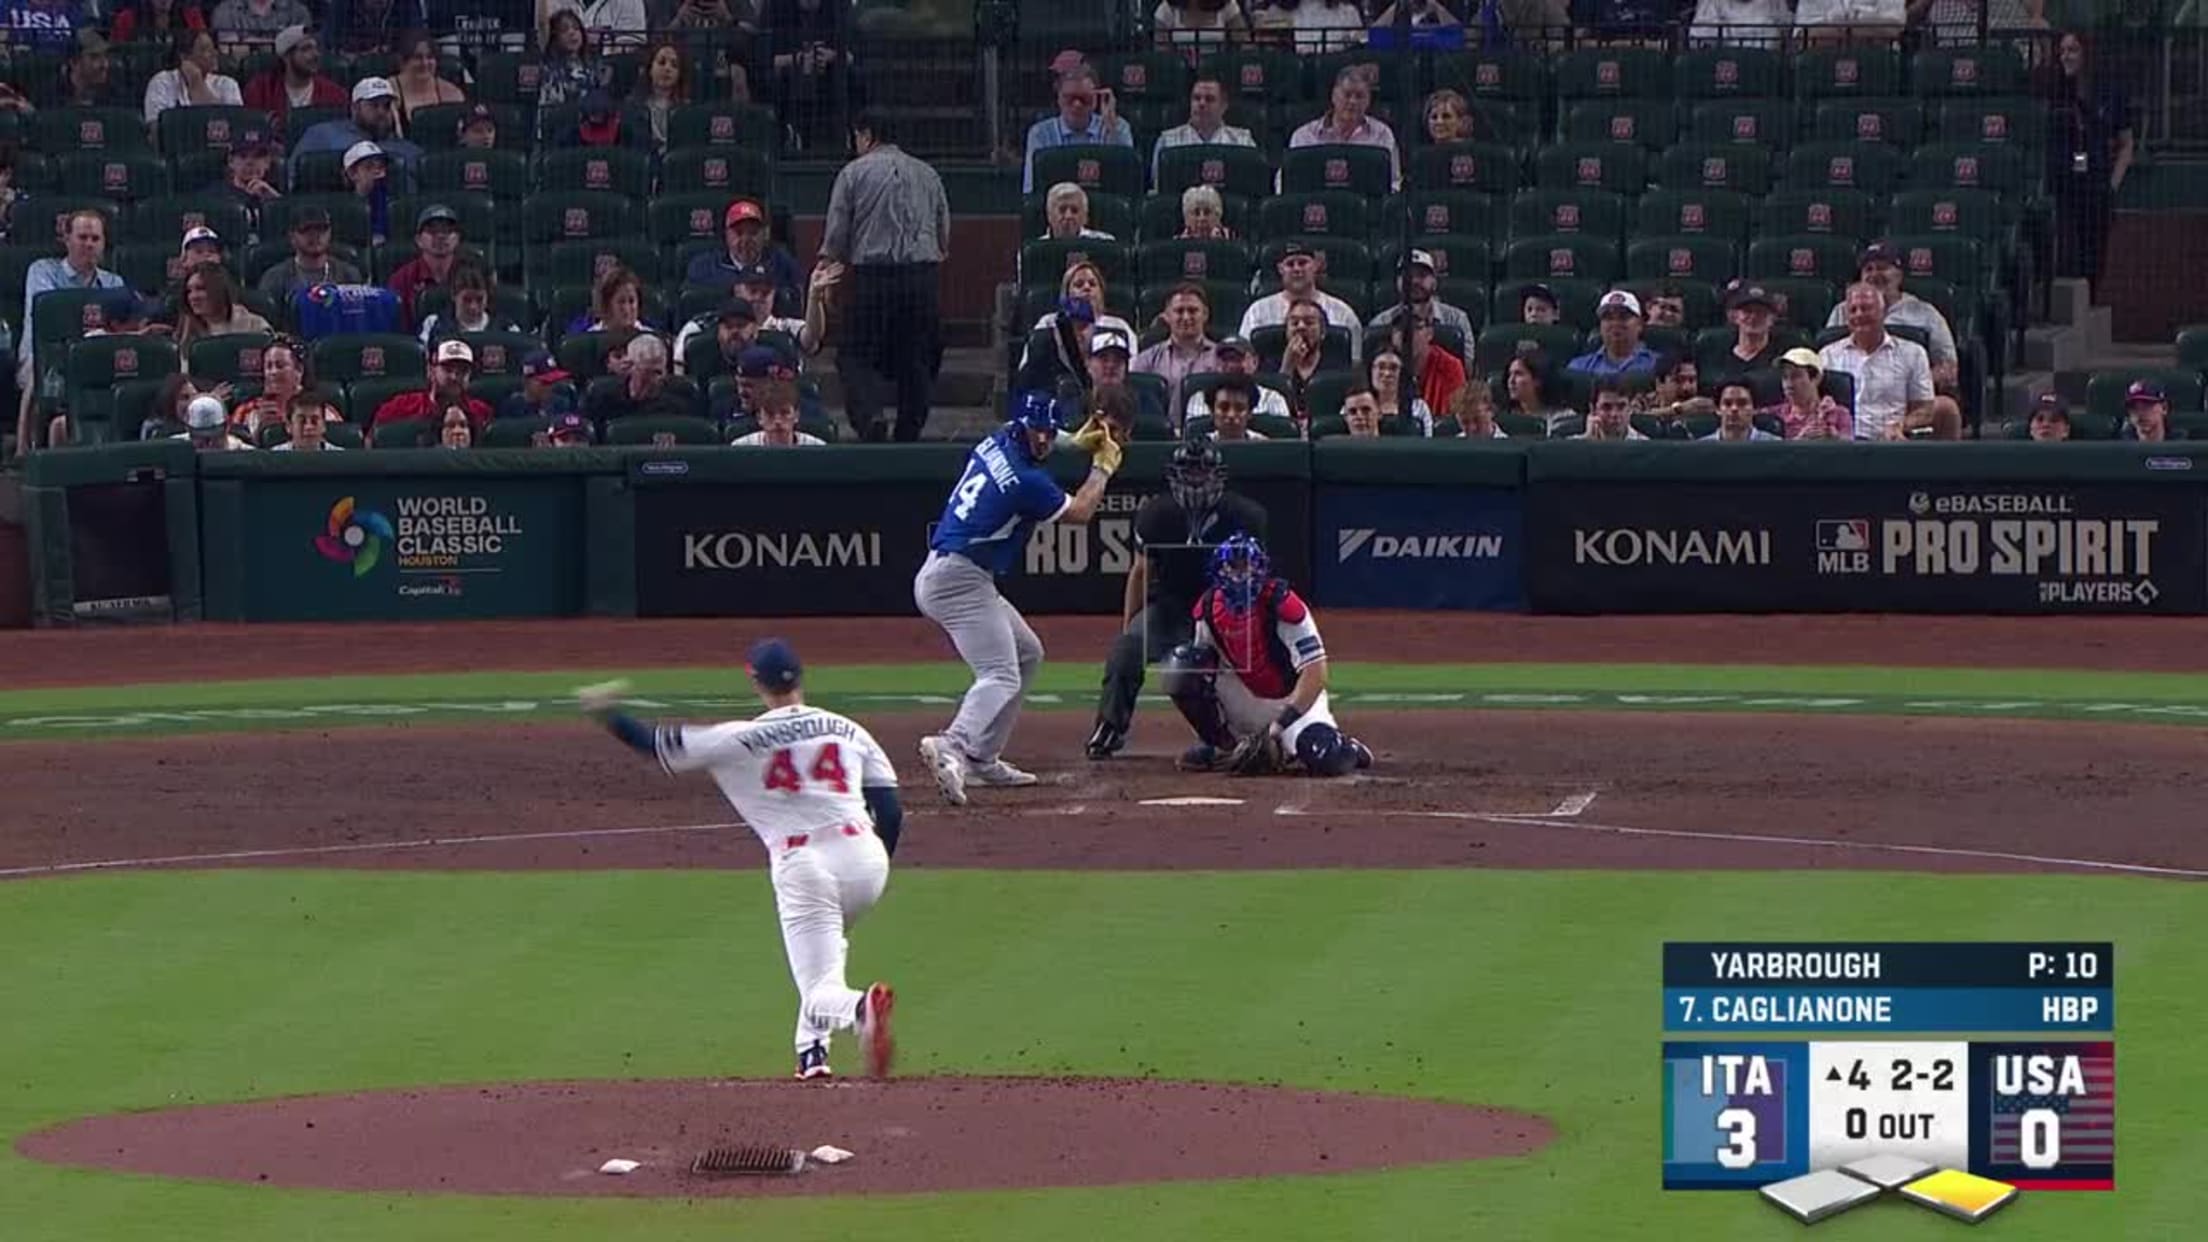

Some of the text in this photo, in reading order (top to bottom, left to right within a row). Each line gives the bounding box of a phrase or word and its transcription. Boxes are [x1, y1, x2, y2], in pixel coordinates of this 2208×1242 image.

[10, 8, 71, 37] USA
[397, 497, 487, 516] WORLD
[1935, 495, 2072, 513] eBASEBALL
[398, 515, 522, 536] BASEBALL
[398, 536, 502, 555] CLASSIC
[685, 533, 880, 568] KONAMI
[1371, 536, 1502, 558] DAIKIN
[1575, 529, 1770, 565] KONAMI
[1883, 520, 2159, 574] PRO SPIRIT
[398, 555, 458, 567] HOUSTON
[1818, 552, 1869, 574] MLB
[2048, 582, 2133, 602] PLAYERS
[763, 742, 850, 794] 44
